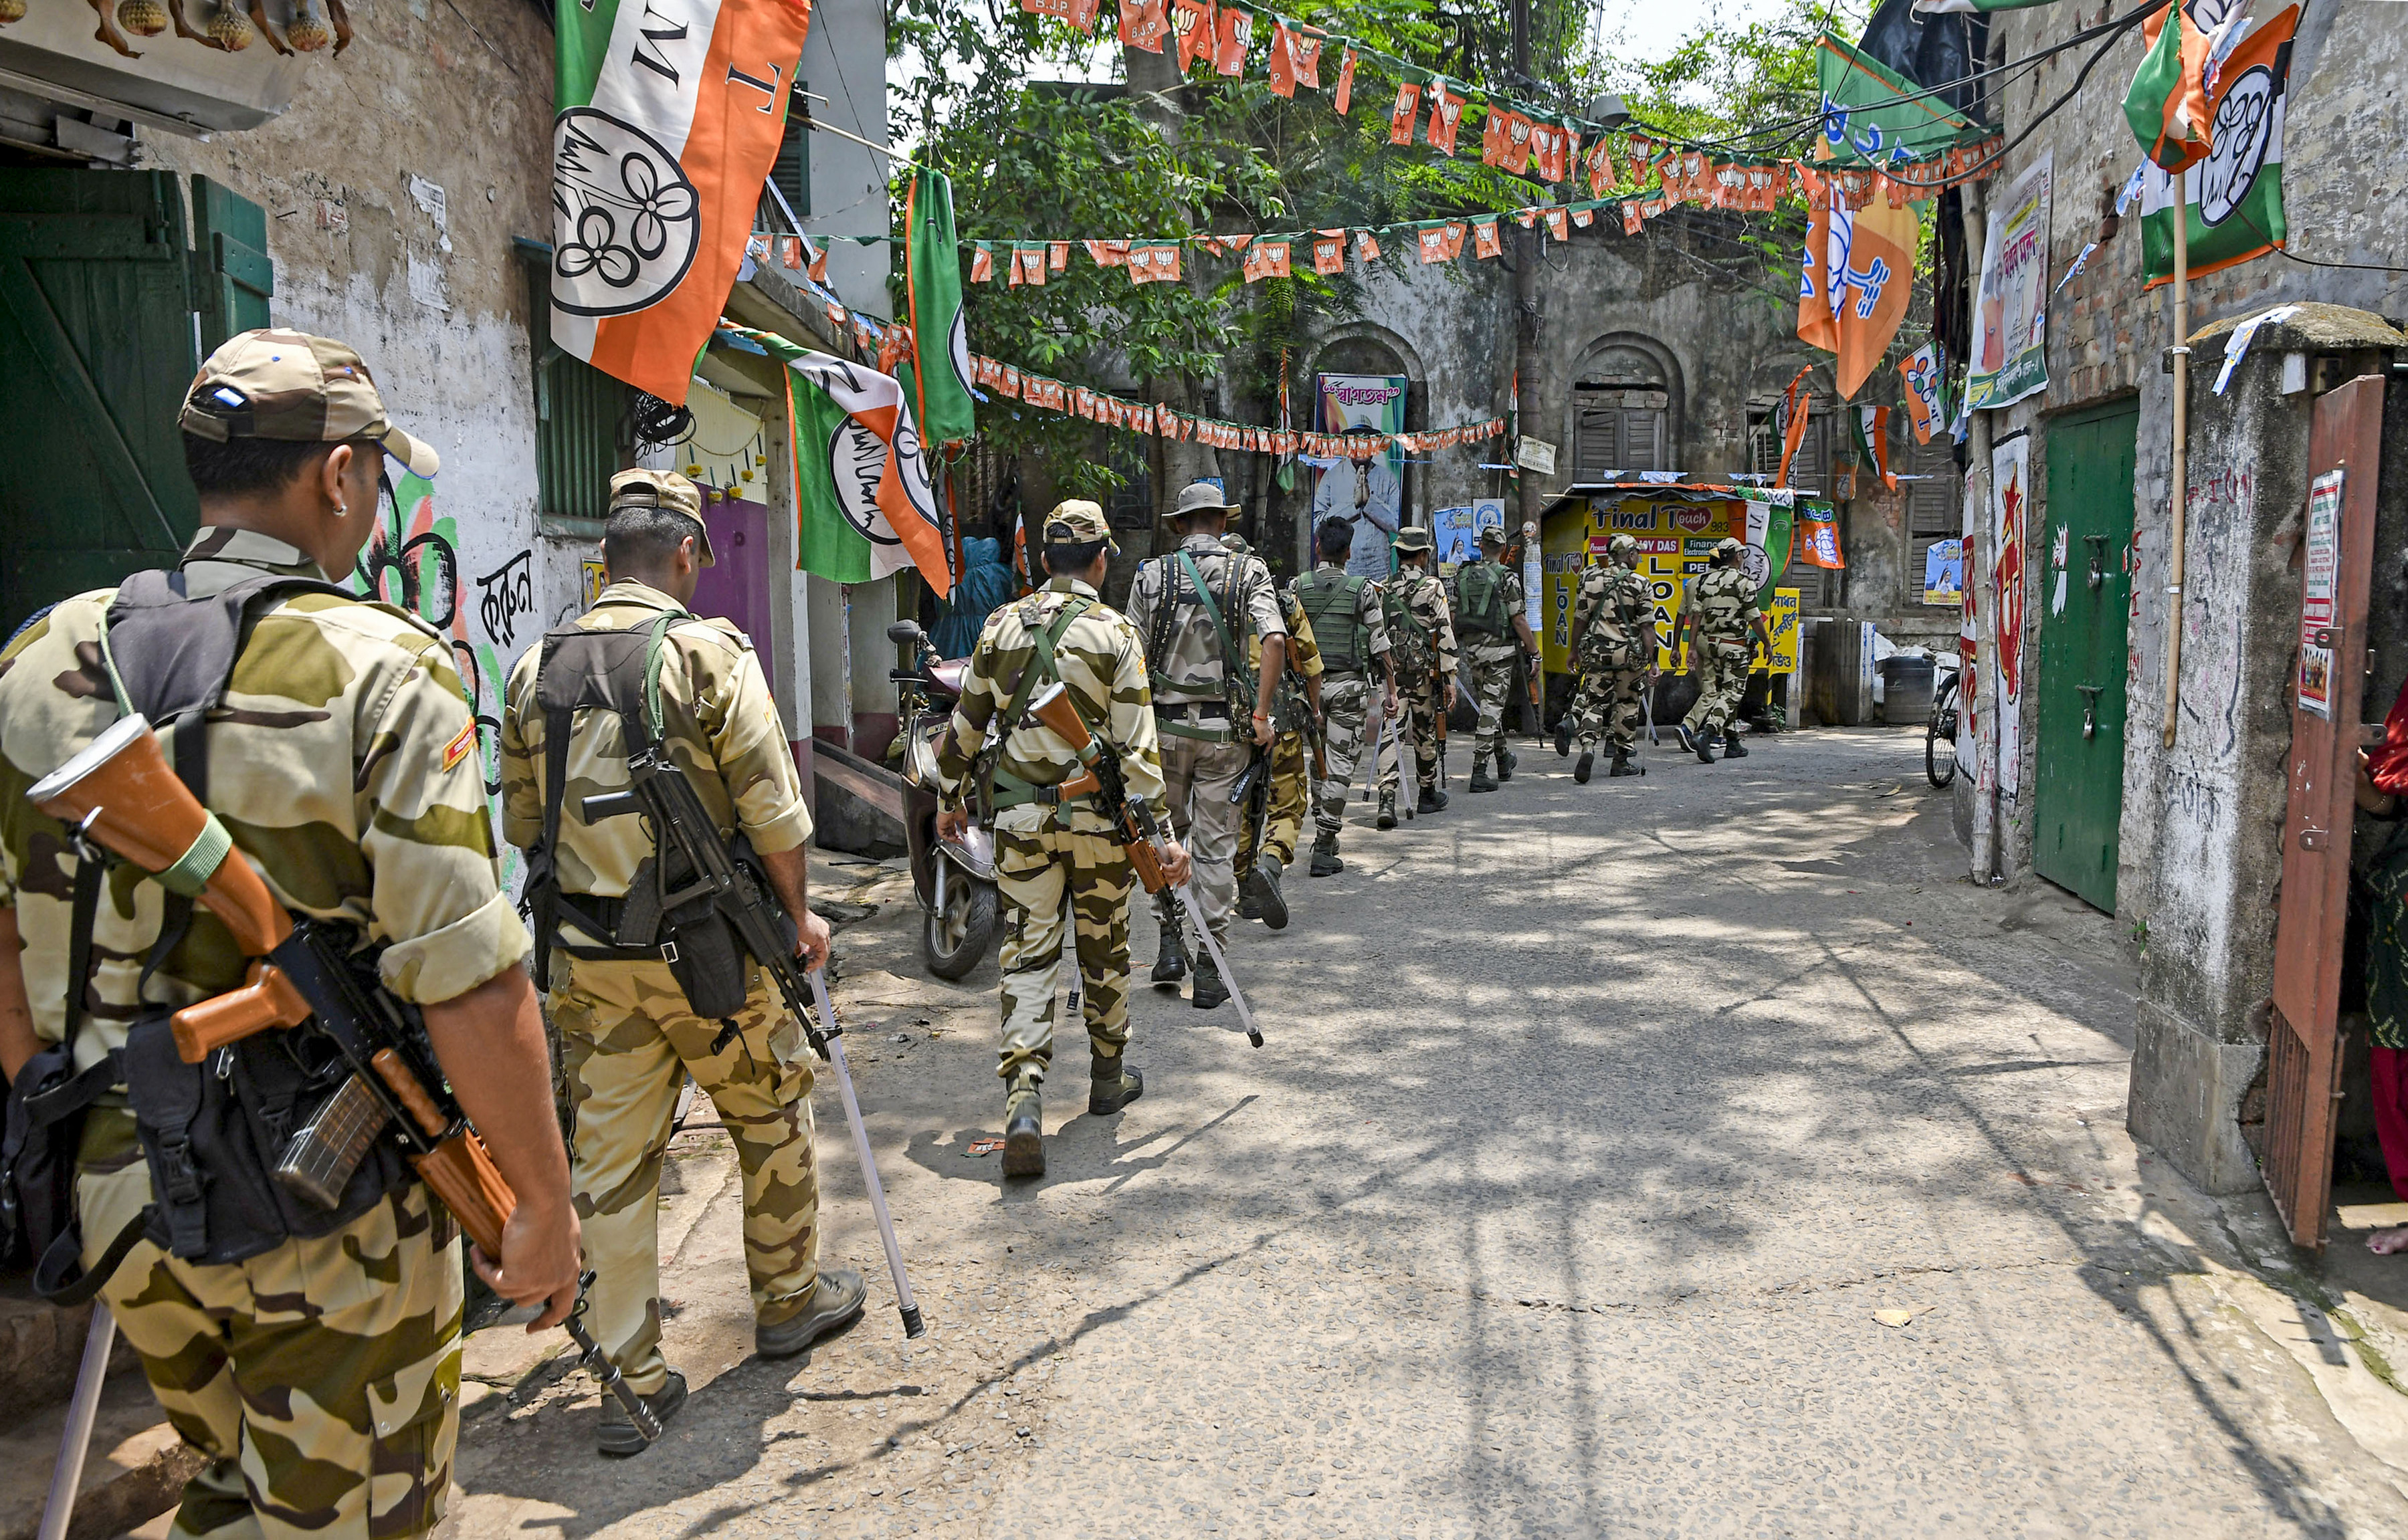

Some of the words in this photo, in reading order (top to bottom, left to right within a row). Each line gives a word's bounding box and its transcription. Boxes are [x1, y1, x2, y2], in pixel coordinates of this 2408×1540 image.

[1132, 23, 1160, 37] B.J.P.
[1591, 503, 1658, 530] Final
[1660, 504, 1707, 530] Touch
[1657, 540, 1677, 552] DAS
[1544, 553, 1564, 574] Final
[1554, 577, 1569, 647] LOAN
[1649, 556, 1675, 650] LOAN
